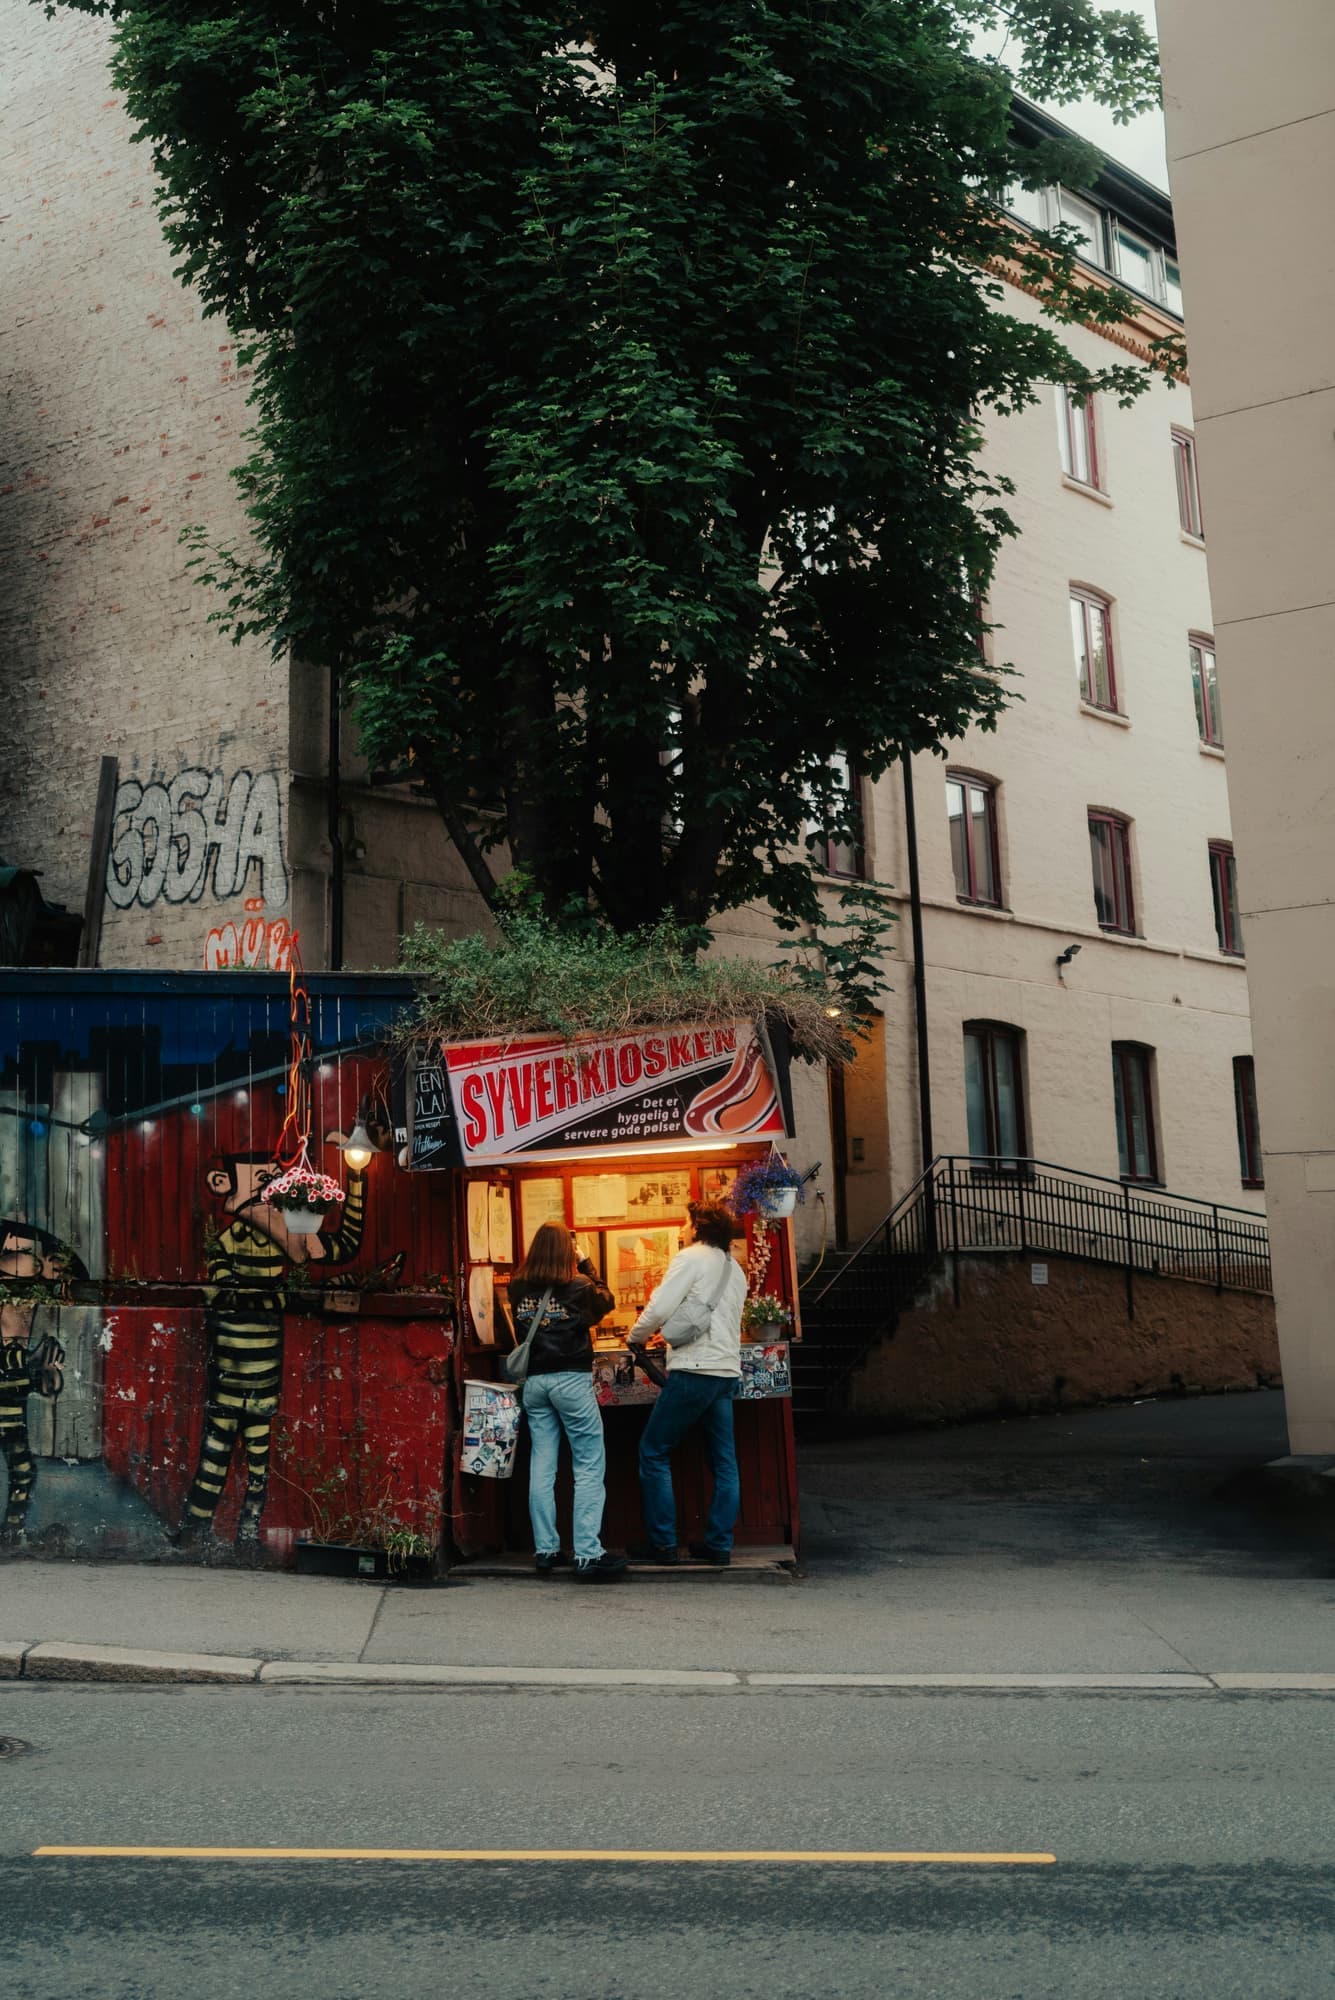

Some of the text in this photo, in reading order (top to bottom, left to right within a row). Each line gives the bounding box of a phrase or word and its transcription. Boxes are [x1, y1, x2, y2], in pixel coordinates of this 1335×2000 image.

[461, 1027, 737, 1150] SYVERKIOSKEN
[642, 1098, 663, 1109] Det
[666, 1098, 679, 1107] er
[617, 1108, 680, 1125] hyggelig å
[564, 1122, 681, 1140] servere gode pølser
